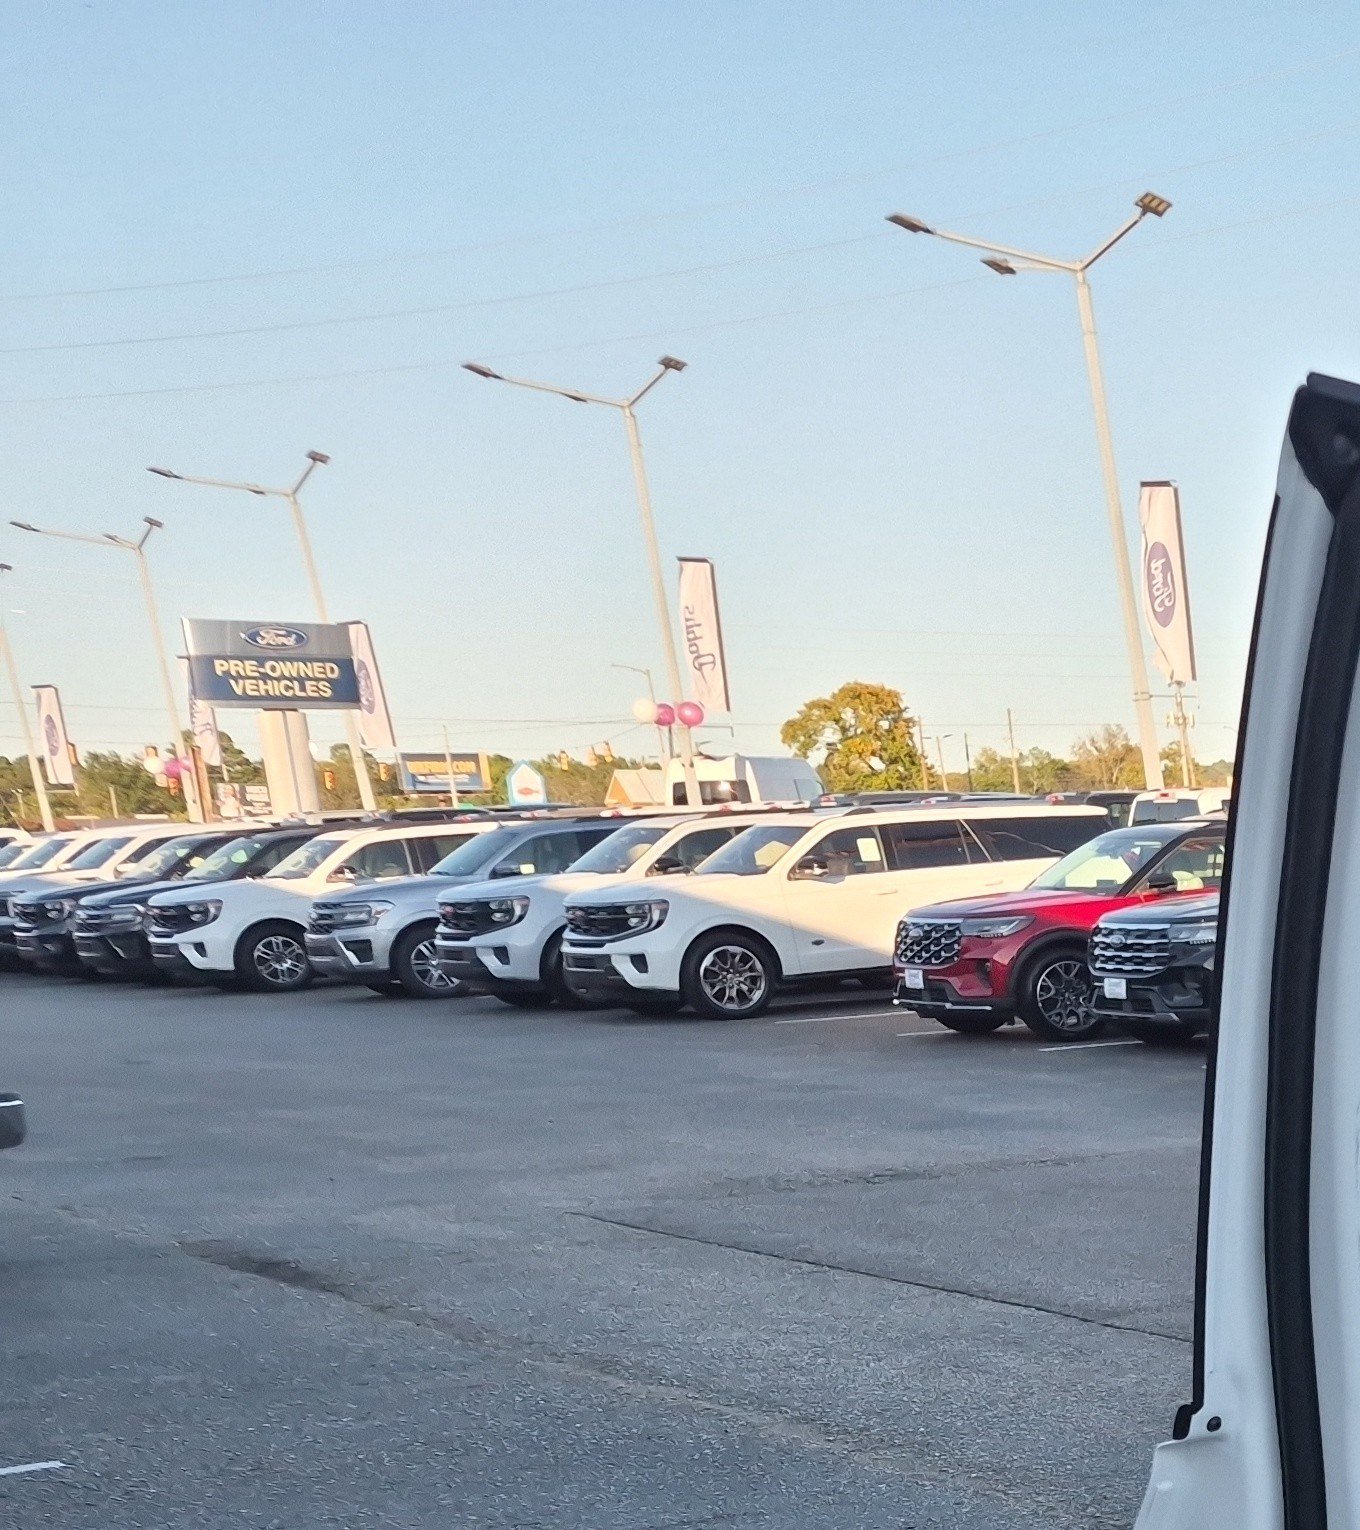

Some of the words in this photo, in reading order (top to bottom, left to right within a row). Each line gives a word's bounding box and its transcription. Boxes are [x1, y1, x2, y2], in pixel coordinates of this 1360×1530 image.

[256, 628, 297, 646] Ford
[213, 659, 340, 680] PRE-OWNED
[229, 678, 334, 698] VEHICLES
